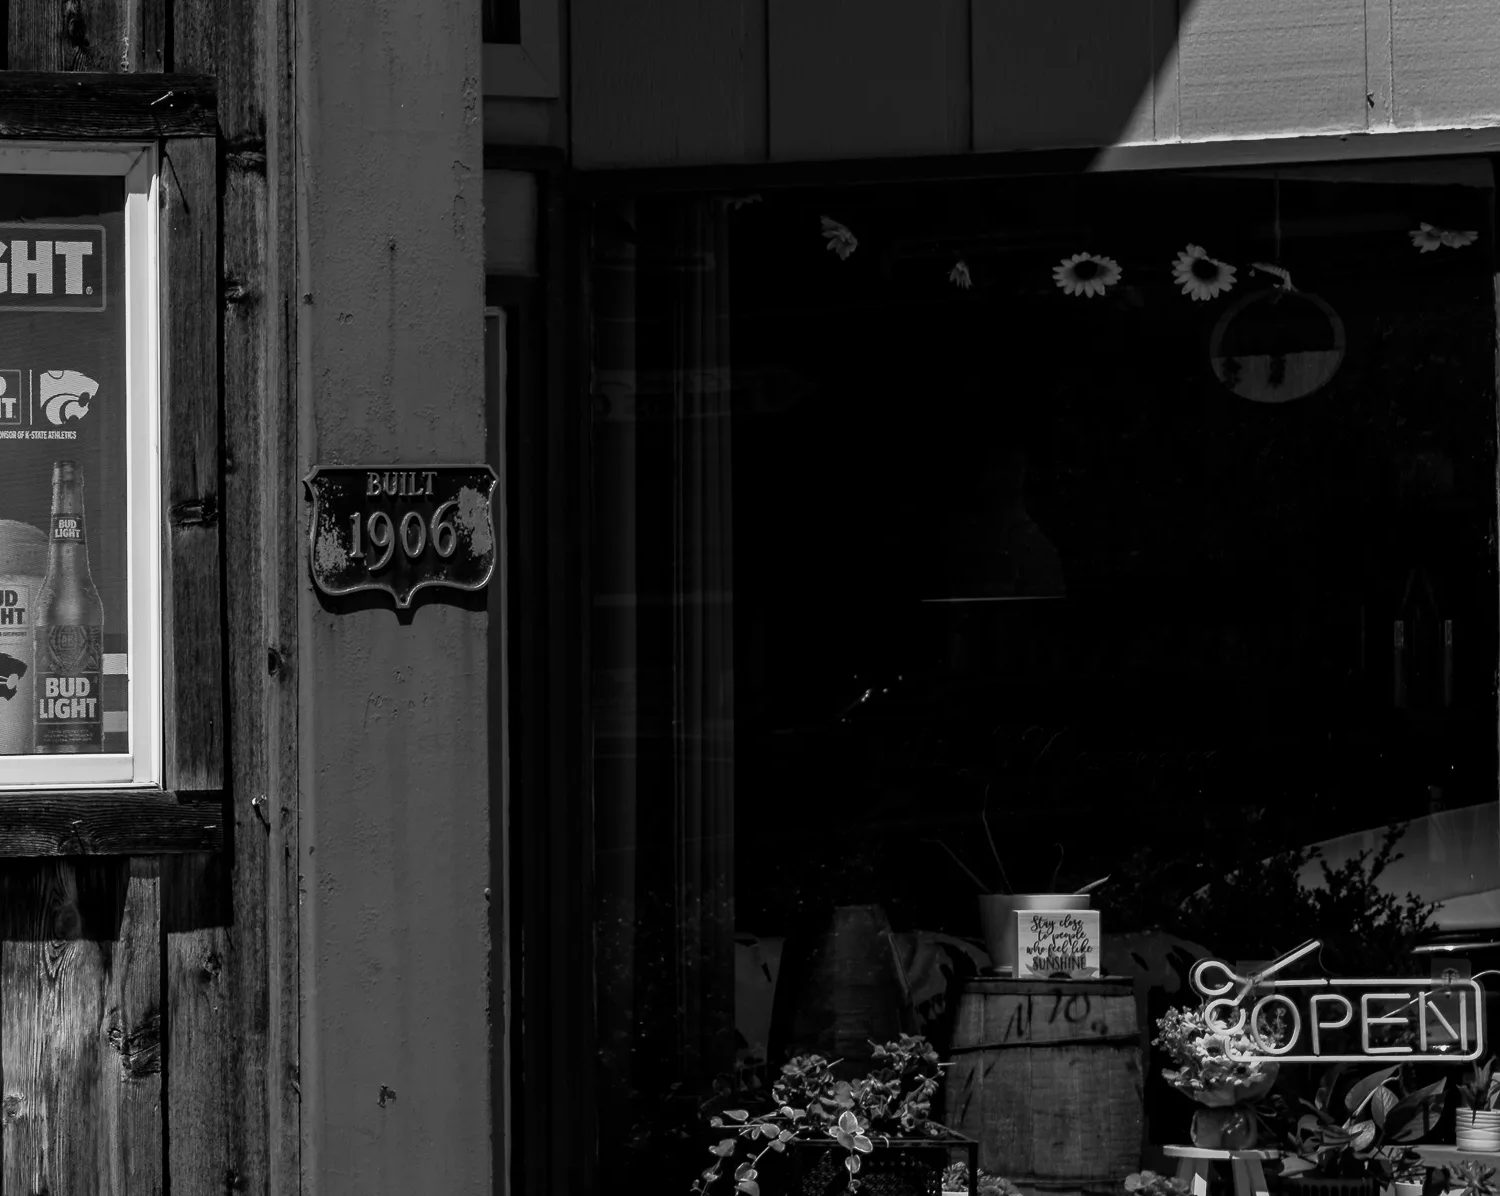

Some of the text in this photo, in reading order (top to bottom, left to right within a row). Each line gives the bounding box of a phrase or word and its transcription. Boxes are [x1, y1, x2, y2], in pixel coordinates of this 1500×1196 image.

[17, 430, 25, 439] OF
[25, 430, 47, 440] K-STATE
[48, 430, 77, 440] ATHLETICS
[366, 471, 438, 496] BUILT
[55, 528, 81, 538] LIGHT
[58, 519, 77, 529] BUD
[350, 500, 458, 570] 1906
[45, 677, 91, 698] BUD
[39, 698, 97, 719] LIGHT
[1031, 914, 1084, 935] Stay close
[1038, 927, 1087, 947] to people
[1026, 938, 1093, 957] who feel like
[1033, 955, 1086, 970] SUNSHINE
[1251, 991, 1468, 1055] OPEN
